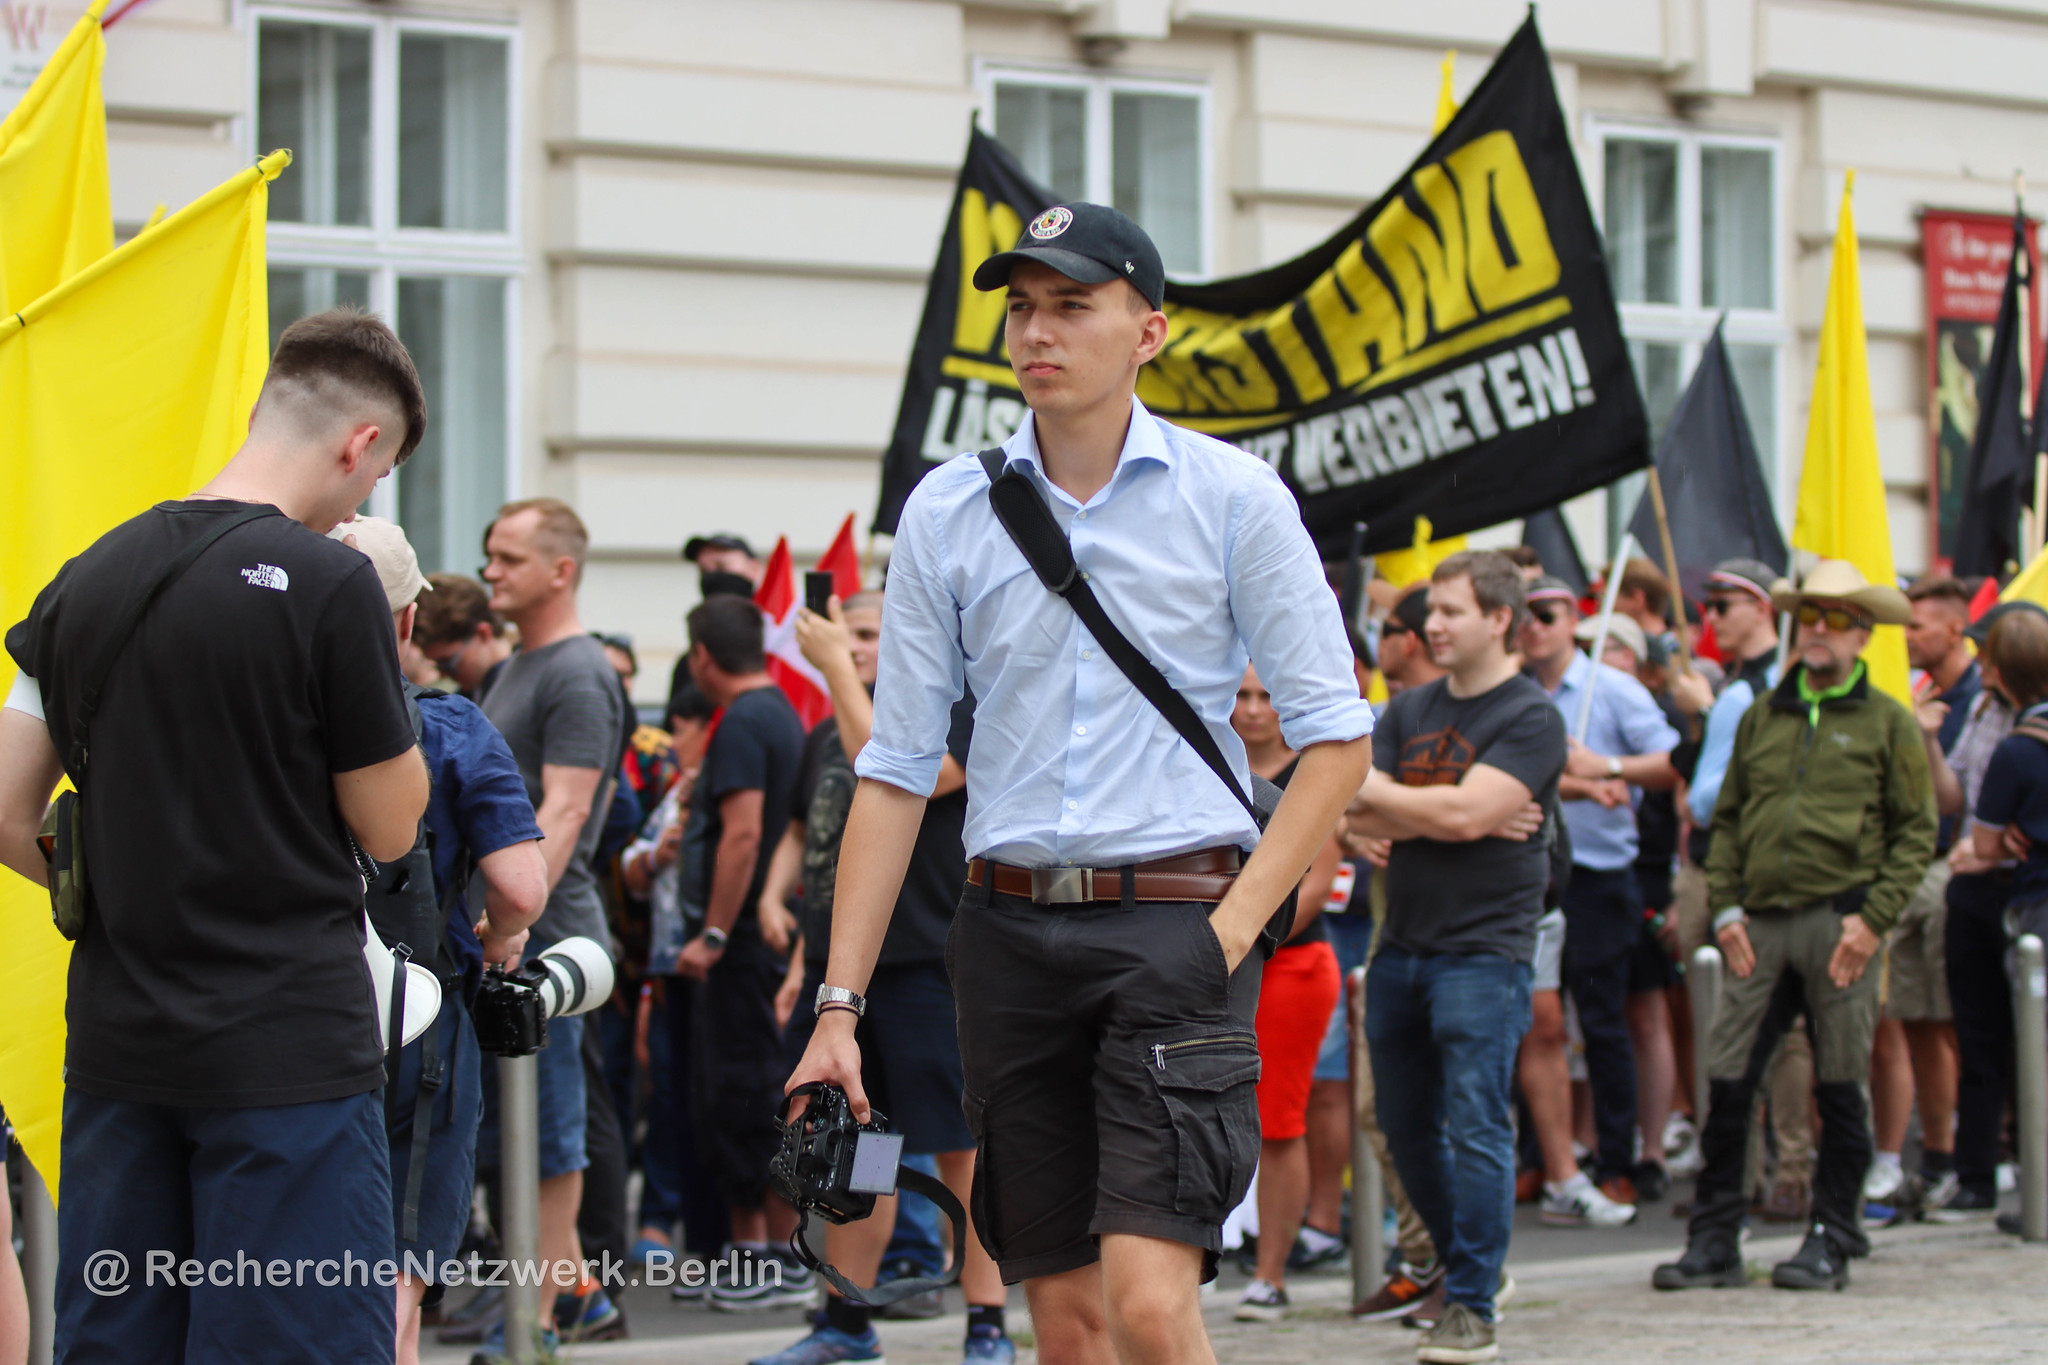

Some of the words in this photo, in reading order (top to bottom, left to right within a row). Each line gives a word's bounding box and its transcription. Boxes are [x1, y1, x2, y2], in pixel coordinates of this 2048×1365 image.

[1292, 327, 1596, 494] VERBIETEN!
[257, 563, 275, 573] THE
[241, 568, 273, 581] NORTH
[247, 576, 270, 588] FACE
